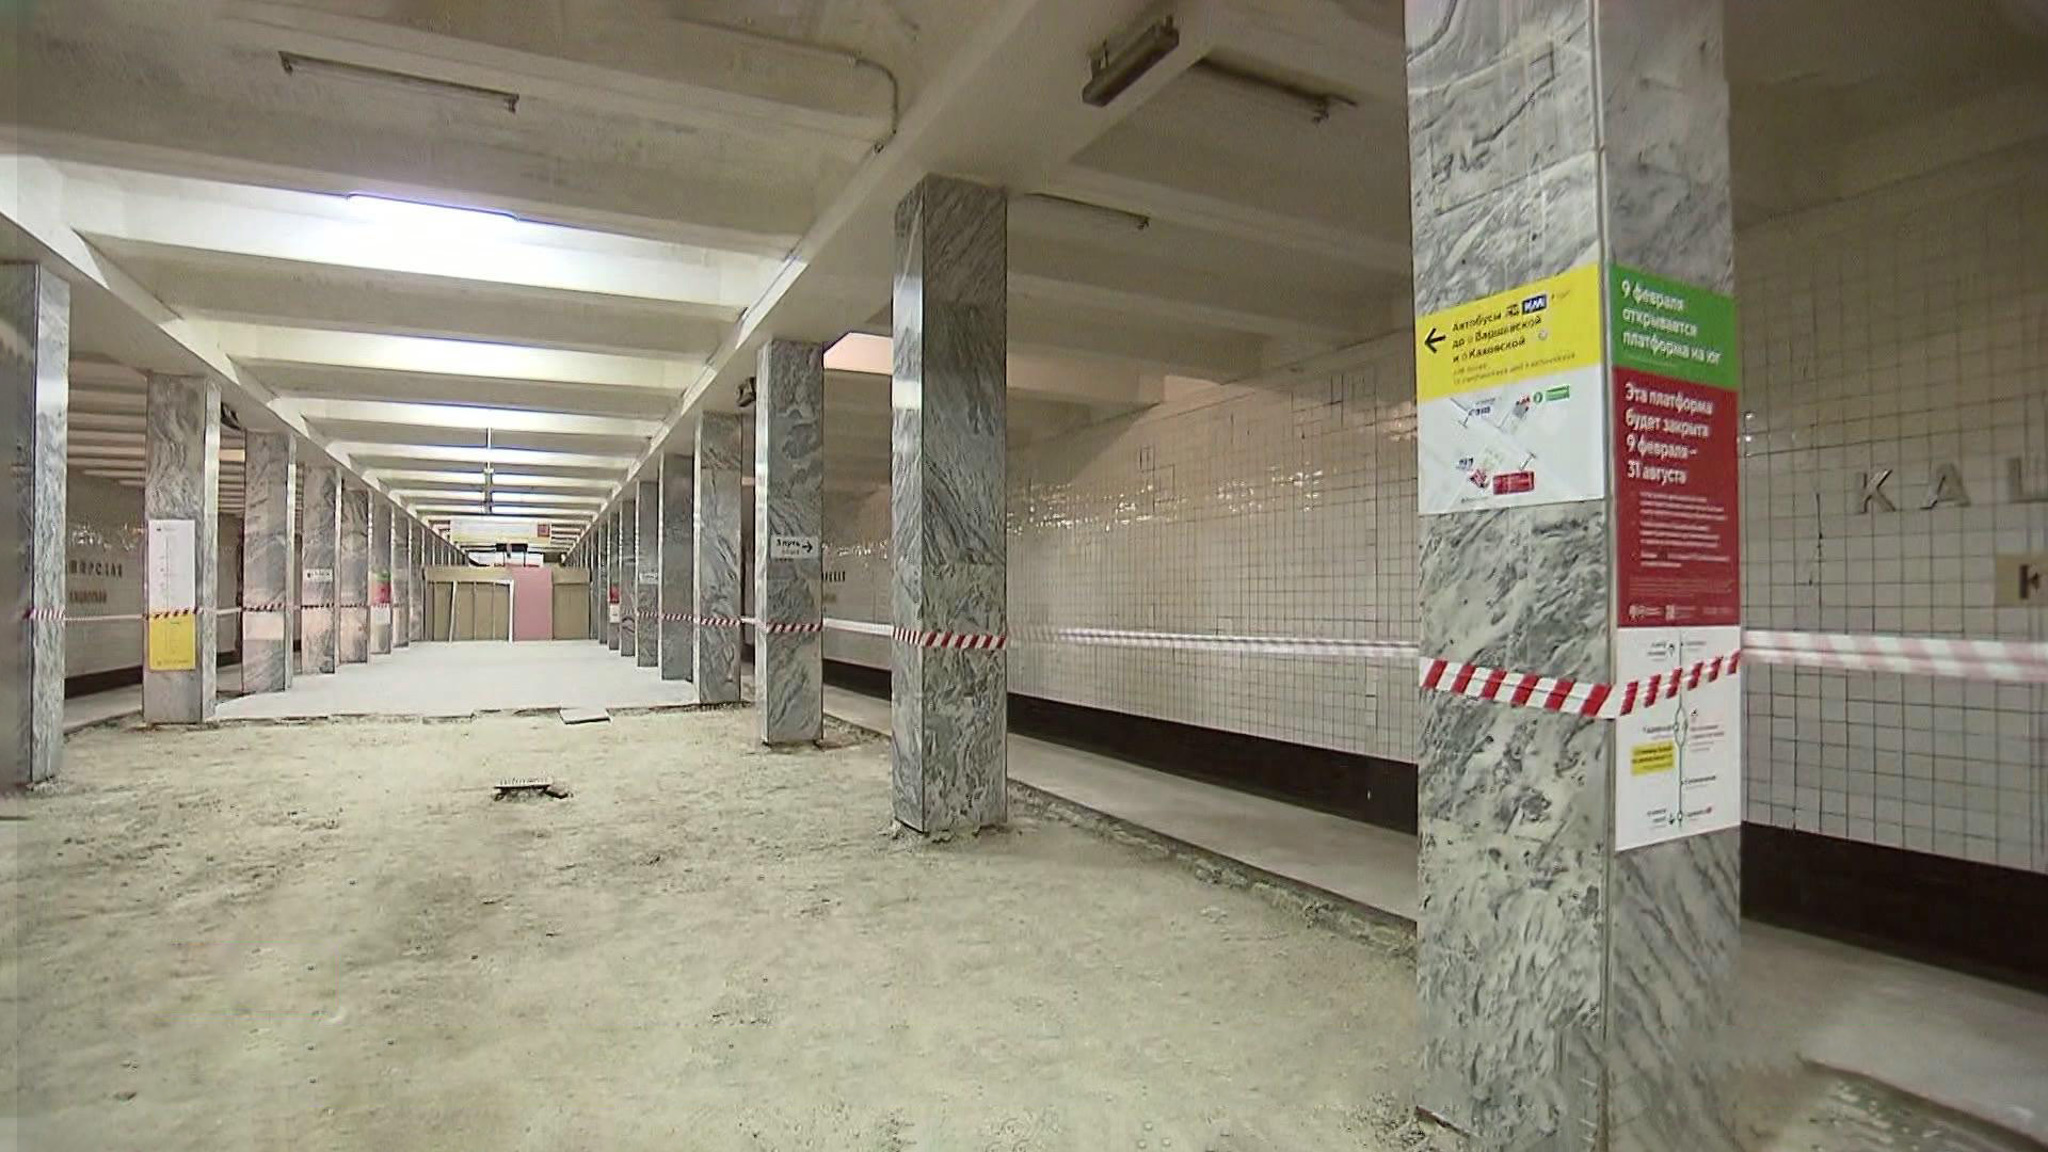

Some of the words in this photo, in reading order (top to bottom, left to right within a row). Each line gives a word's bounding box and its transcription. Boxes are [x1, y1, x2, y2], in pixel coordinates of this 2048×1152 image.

[1621, 280, 1631, 299] 9
[1623, 332, 1690, 358] платформа
[1690, 346, 1705, 361] на
[1625, 382, 1648, 403] Эта
[1648, 391, 1714, 416] платформа
[1625, 408, 1661, 431] будет
[1626, 433, 1635, 453] 9
[1627, 460, 1641, 479] 31
[1642, 466, 1687, 486] августа
